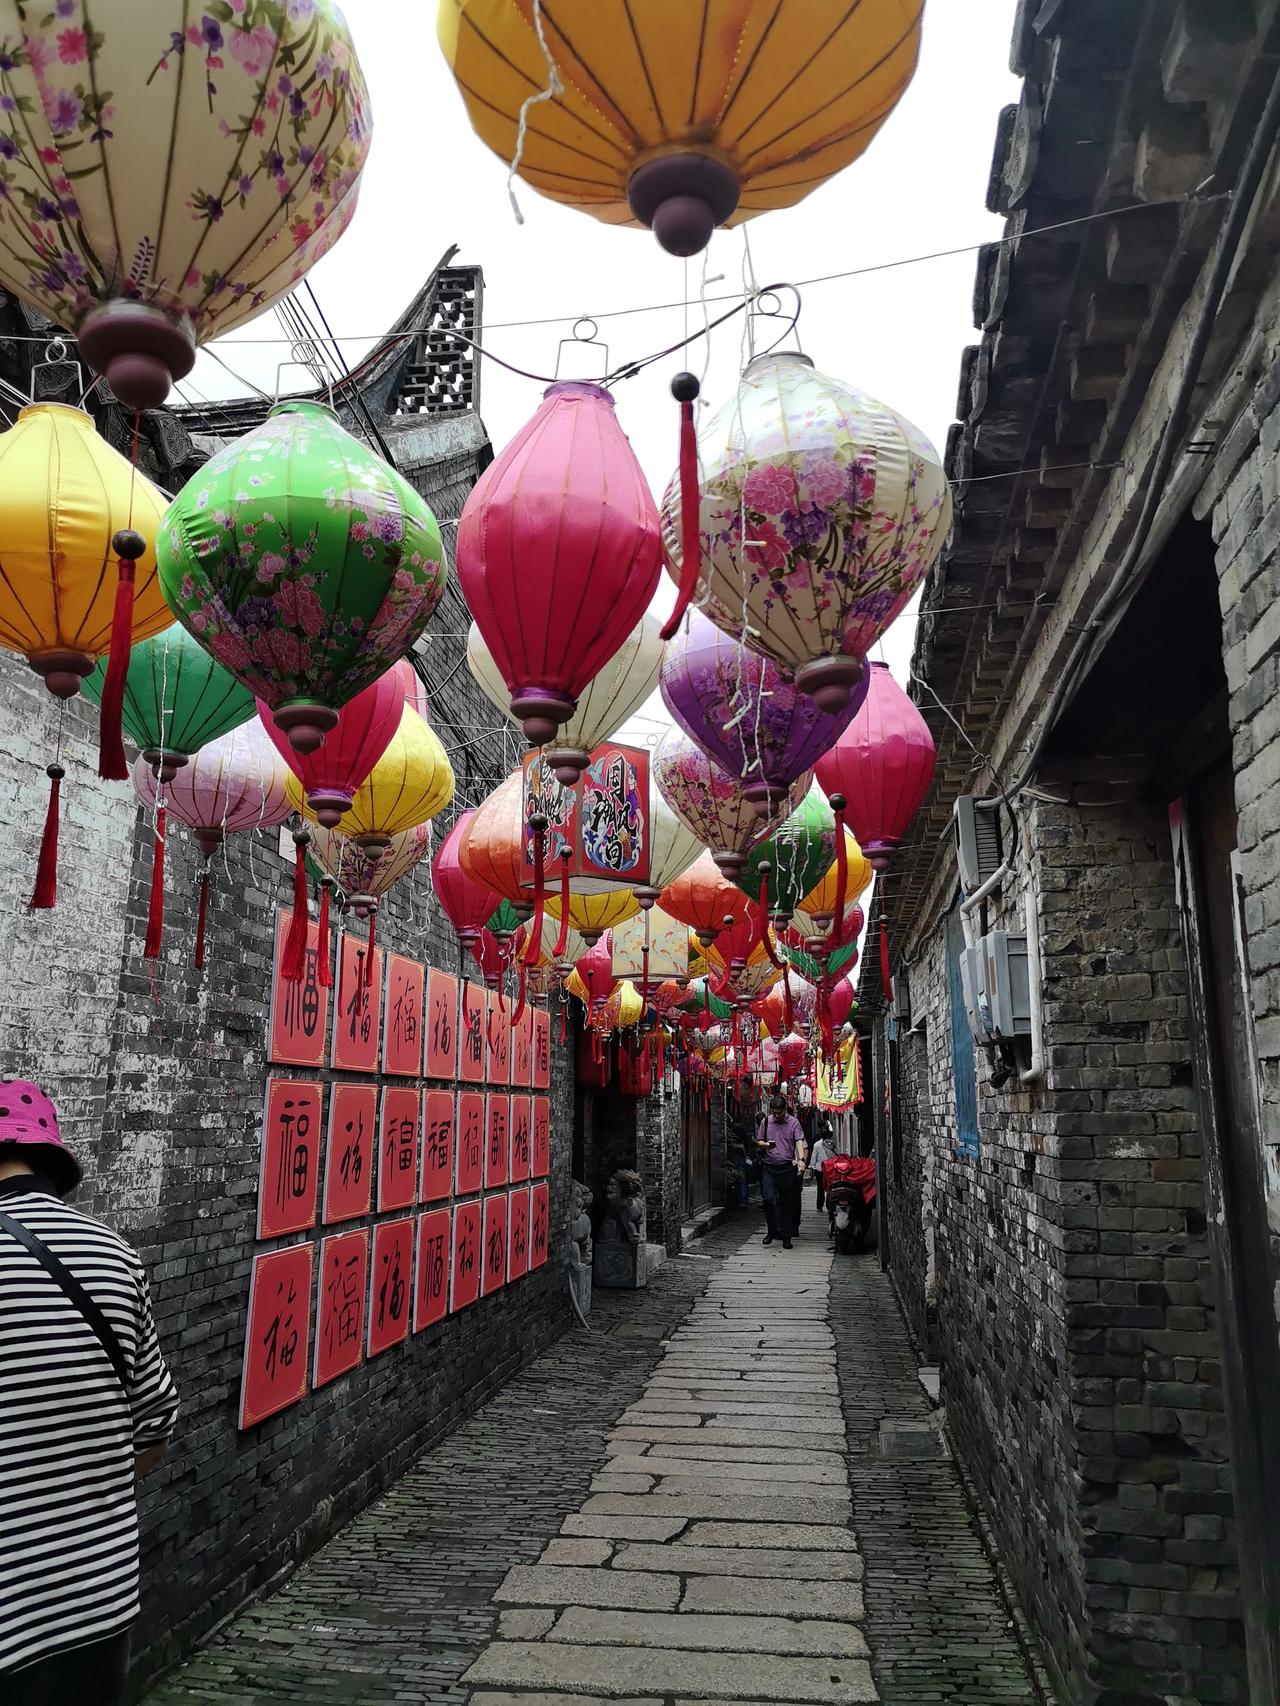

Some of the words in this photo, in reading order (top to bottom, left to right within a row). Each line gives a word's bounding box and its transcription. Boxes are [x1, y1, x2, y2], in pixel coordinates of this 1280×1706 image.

[393, 976, 416, 1052] 福
[434, 993, 451, 1056] 福
[466, 1008, 482, 1064] 福
[277, 1100, 311, 1212] 福
[340, 1111, 363, 1189] 福
[386, 1115, 414, 1183] 福
[428, 1120, 451, 1170] 福
[464, 1111, 479, 1173] 福
[515, 1115, 528, 1164] 福
[424, 1234, 444, 1308] 福
[459, 1215, 474, 1278] 福
[325, 1255, 360, 1360] 福
[378, 1240, 404, 1329] 福
[264, 1278, 298, 1382] 福
